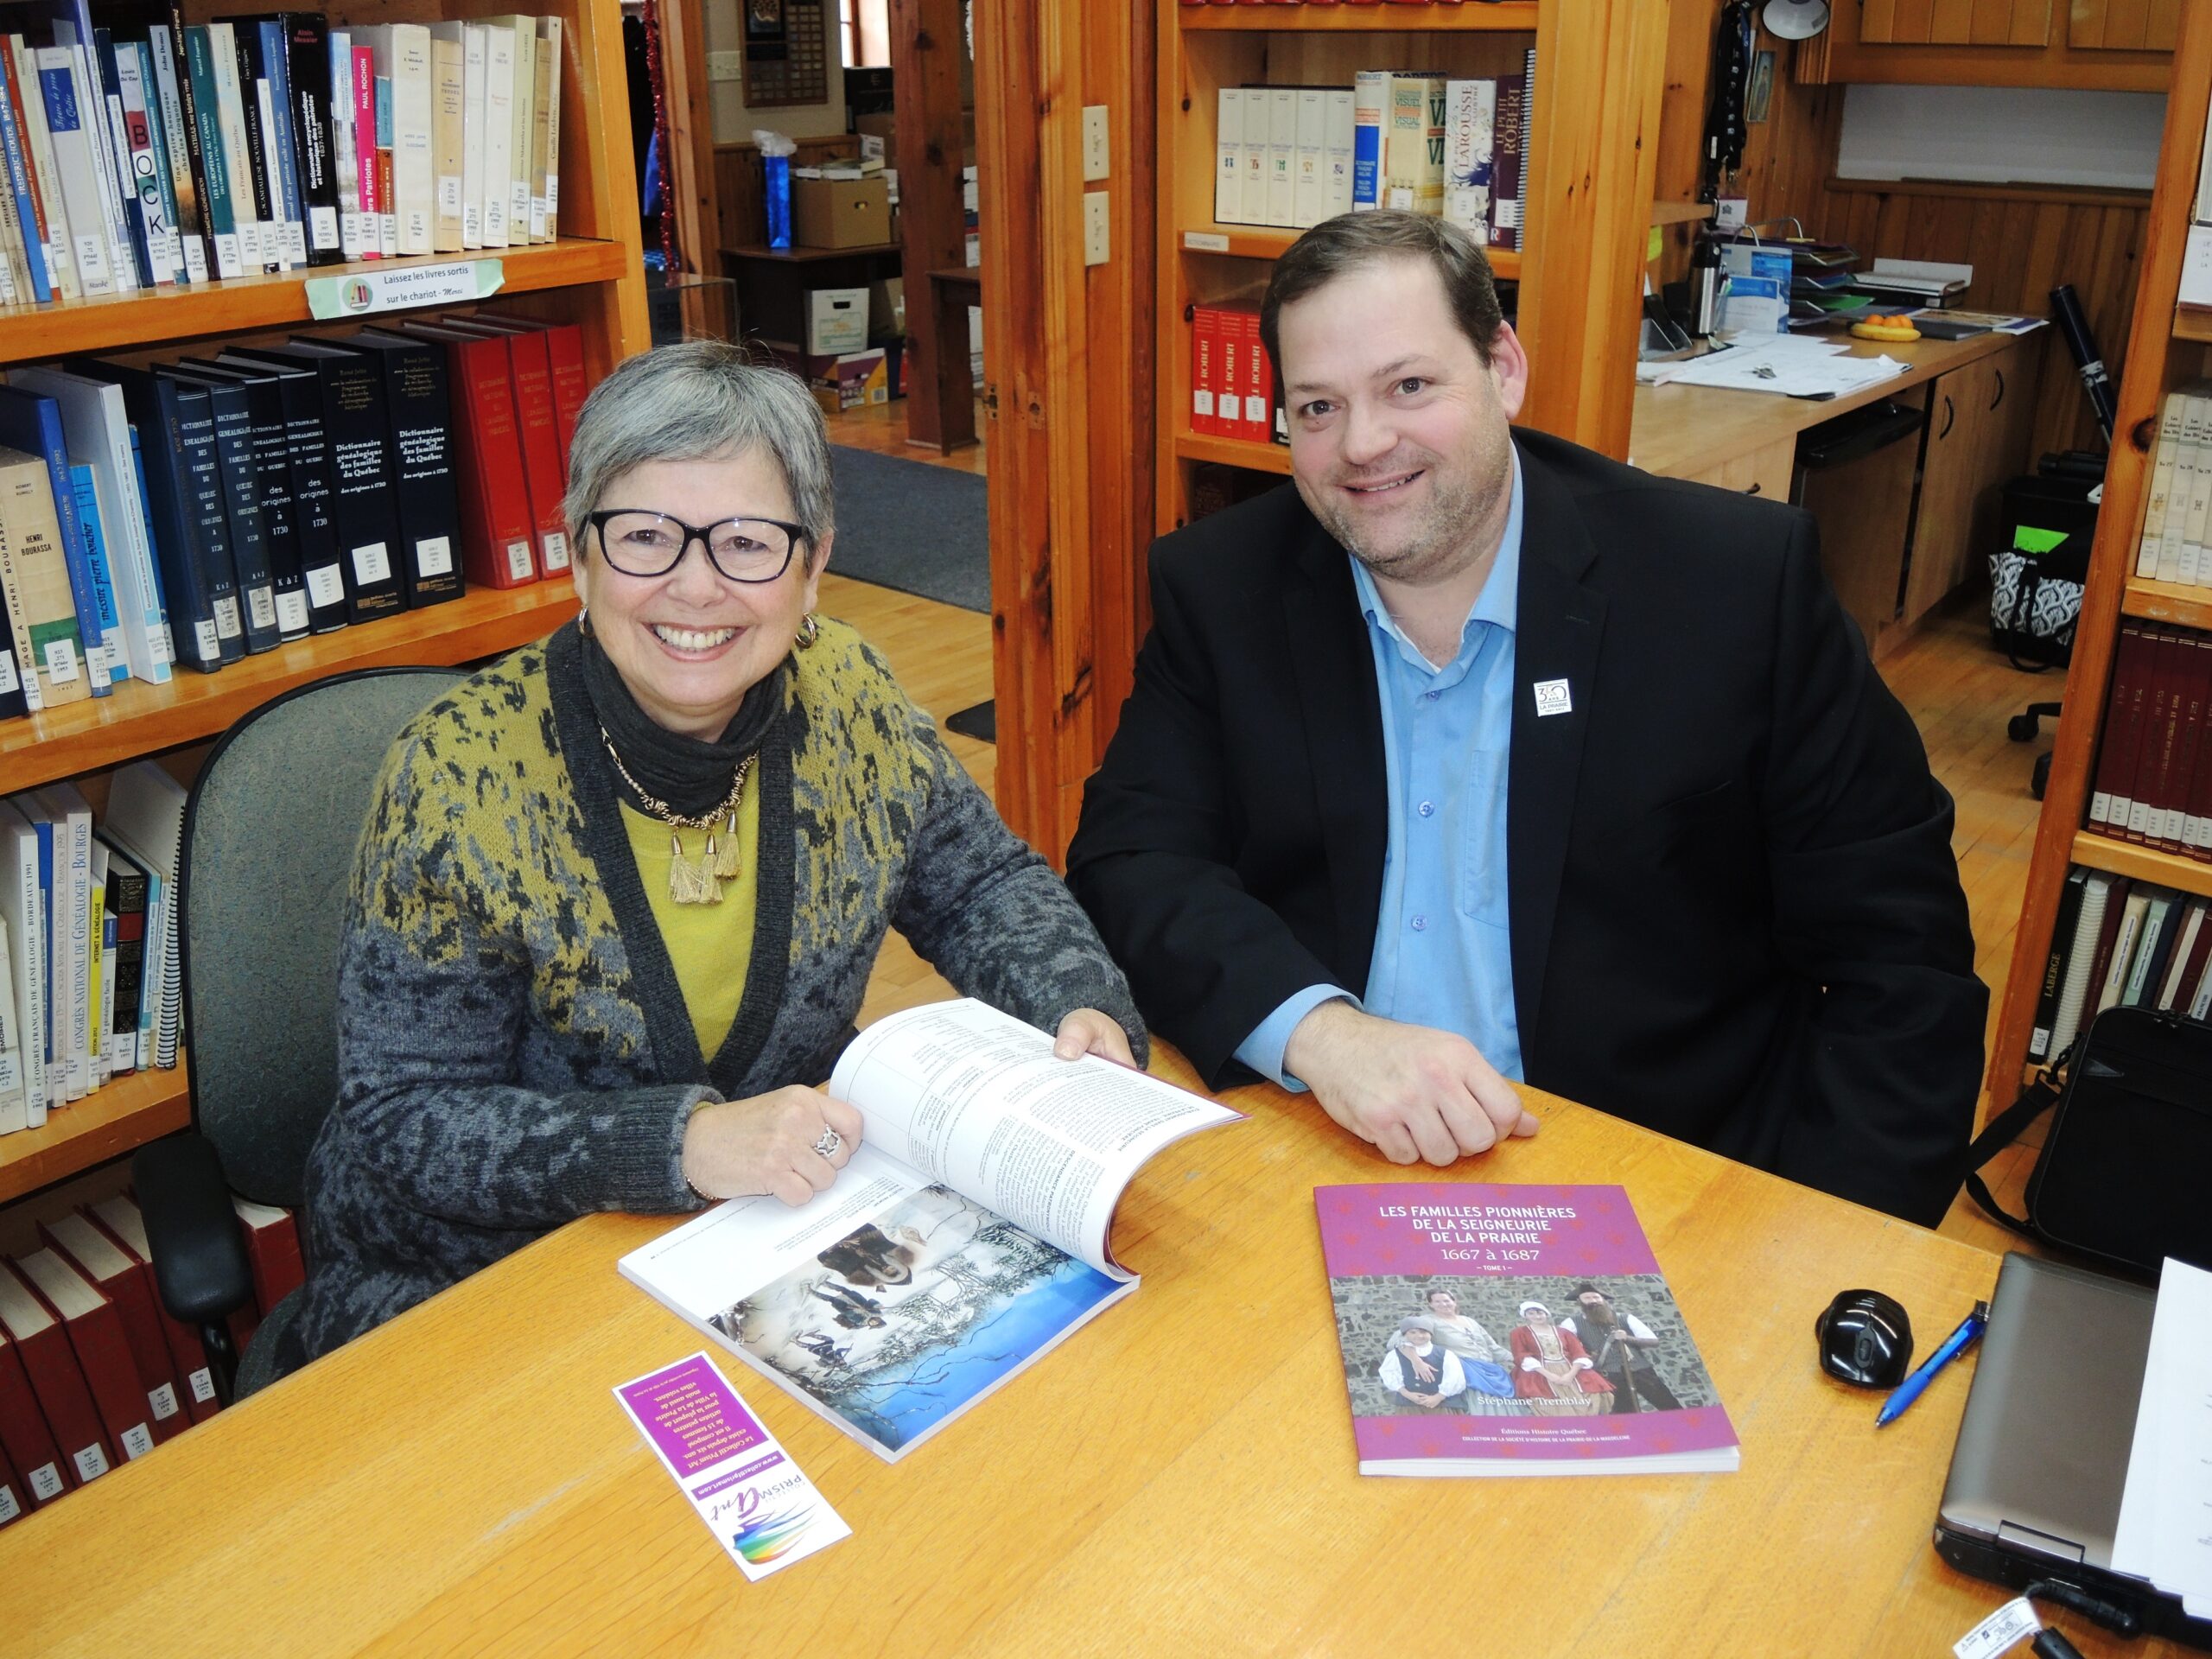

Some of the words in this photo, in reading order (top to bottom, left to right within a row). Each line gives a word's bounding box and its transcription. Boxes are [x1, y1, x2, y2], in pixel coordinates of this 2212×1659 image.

[164, 92, 173, 129] heureuse
[173, 100, 181, 132] Iroquois
[308, 94, 318, 128] patriotes
[1497, 98, 1507, 128] PETIT
[302, 91, 313, 145] encyclopédique
[1394, 116, 1421, 124] VISUAL
[1503, 88, 1520, 154] ROBERT
[1459, 85, 1472, 168] LAROUSSE
[1496, 131, 1505, 144] LE
[169, 132, 179, 161] captive
[312, 143, 322, 175] historique
[207, 151, 217, 187] EUROPÉENS
[307, 147, 317, 188] Dictionnaire
[364, 157, 372, 194] Patriotes
[256, 167, 266, 209] SCANDALEUSE
[384, 275, 412, 284] Laissez
[413, 271, 423, 280] les
[424, 269, 446, 278] livres
[448, 265, 468, 276] sortis
[400, 293, 407, 302] le
[410, 289, 437, 300] chariot
[1225, 343, 1234, 382] ROBERT
[1251, 346, 1261, 385] ROBERT
[399, 427, 443, 437] Dictionnaire
[336, 440, 380, 451] Dictionnaire
[399, 435, 445, 448] généalogique
[416, 443, 443, 454] familles
[336, 448, 382, 463] généalogique
[353, 456, 381, 468] familles
[416, 453, 442, 462] Québec
[353, 467, 380, 477] Québec
[308, 479, 321, 487] des
[299, 488, 328, 499] origines
[261, 496, 291, 506] origines
[315, 503, 320, 512] à
[276, 510, 282, 519] à
[312, 518, 327, 527] 1730
[272, 525, 288, 535] 1730
[25, 533, 43, 543] HENRI
[83, 523, 95, 556] boucher
[21, 543, 52, 556] BOURASSA
[91, 559, 112, 586] pierre
[96, 588, 110, 620] messire
[71, 822, 86, 869] BOURGES
[72, 878, 86, 939] GÉNÉALOGIE
[75, 941, 85, 953] DE
[74, 957, 85, 1003] NATIONAL
[2044, 952, 2060, 997] LABERGE
[30, 988, 36, 1000] DE
[73, 1007, 84, 1050] CONGRÈS
[1052, 1149, 1076, 1190] DESCENDANCE
[1380, 1206, 1407, 1217] LES
[1410, 1205, 1482, 1217] FAMILLES
[1485, 1205, 1576, 1218] PIONNIÈRES
[1412, 1218, 1433, 1230] DE
[1437, 1218, 1455, 1230] LA
[1459, 1219, 1552, 1230] SEIGNEURIE
[1430, 1231, 1451, 1243] DE
[1456, 1232, 1475, 1243] LA
[1478, 1232, 1541, 1243] PRAIRIE
[1440, 1249, 1479, 1260] 1667
[1485, 1249, 1497, 1260] à
[1501, 1249, 1539, 1261] 1687
[680, 1382, 696, 1390] villes
[653, 1389, 680, 1402] voisines.
[669, 1395, 684, 1406] aussi
[695, 1395, 710, 1404] Ville
[1478, 1396, 1532, 1406] Stéphane
[1537, 1396, 1592, 1407] Tremblay
[703, 1400, 719, 1409] pour
[655, 1409, 677, 1421] Prairie
[672, 1410, 696, 1424] plupart
[699, 1409, 721, 1420] artistes
[672, 1419, 699, 1433] peintres
[682, 1426, 707, 1439] femmes
[728, 1427, 747, 1440] existe
[687, 1433, 715, 1448] composé
[708, 1437, 728, 1448] depuis
[719, 1439, 745, 1453] Collectif
[683, 1451, 696, 1459] ans.
[687, 1452, 719, 1468] Prism'Art
[697, 1455, 778, 1495] www.collectifprismart.com
[759, 1474, 802, 1499] PRISM
